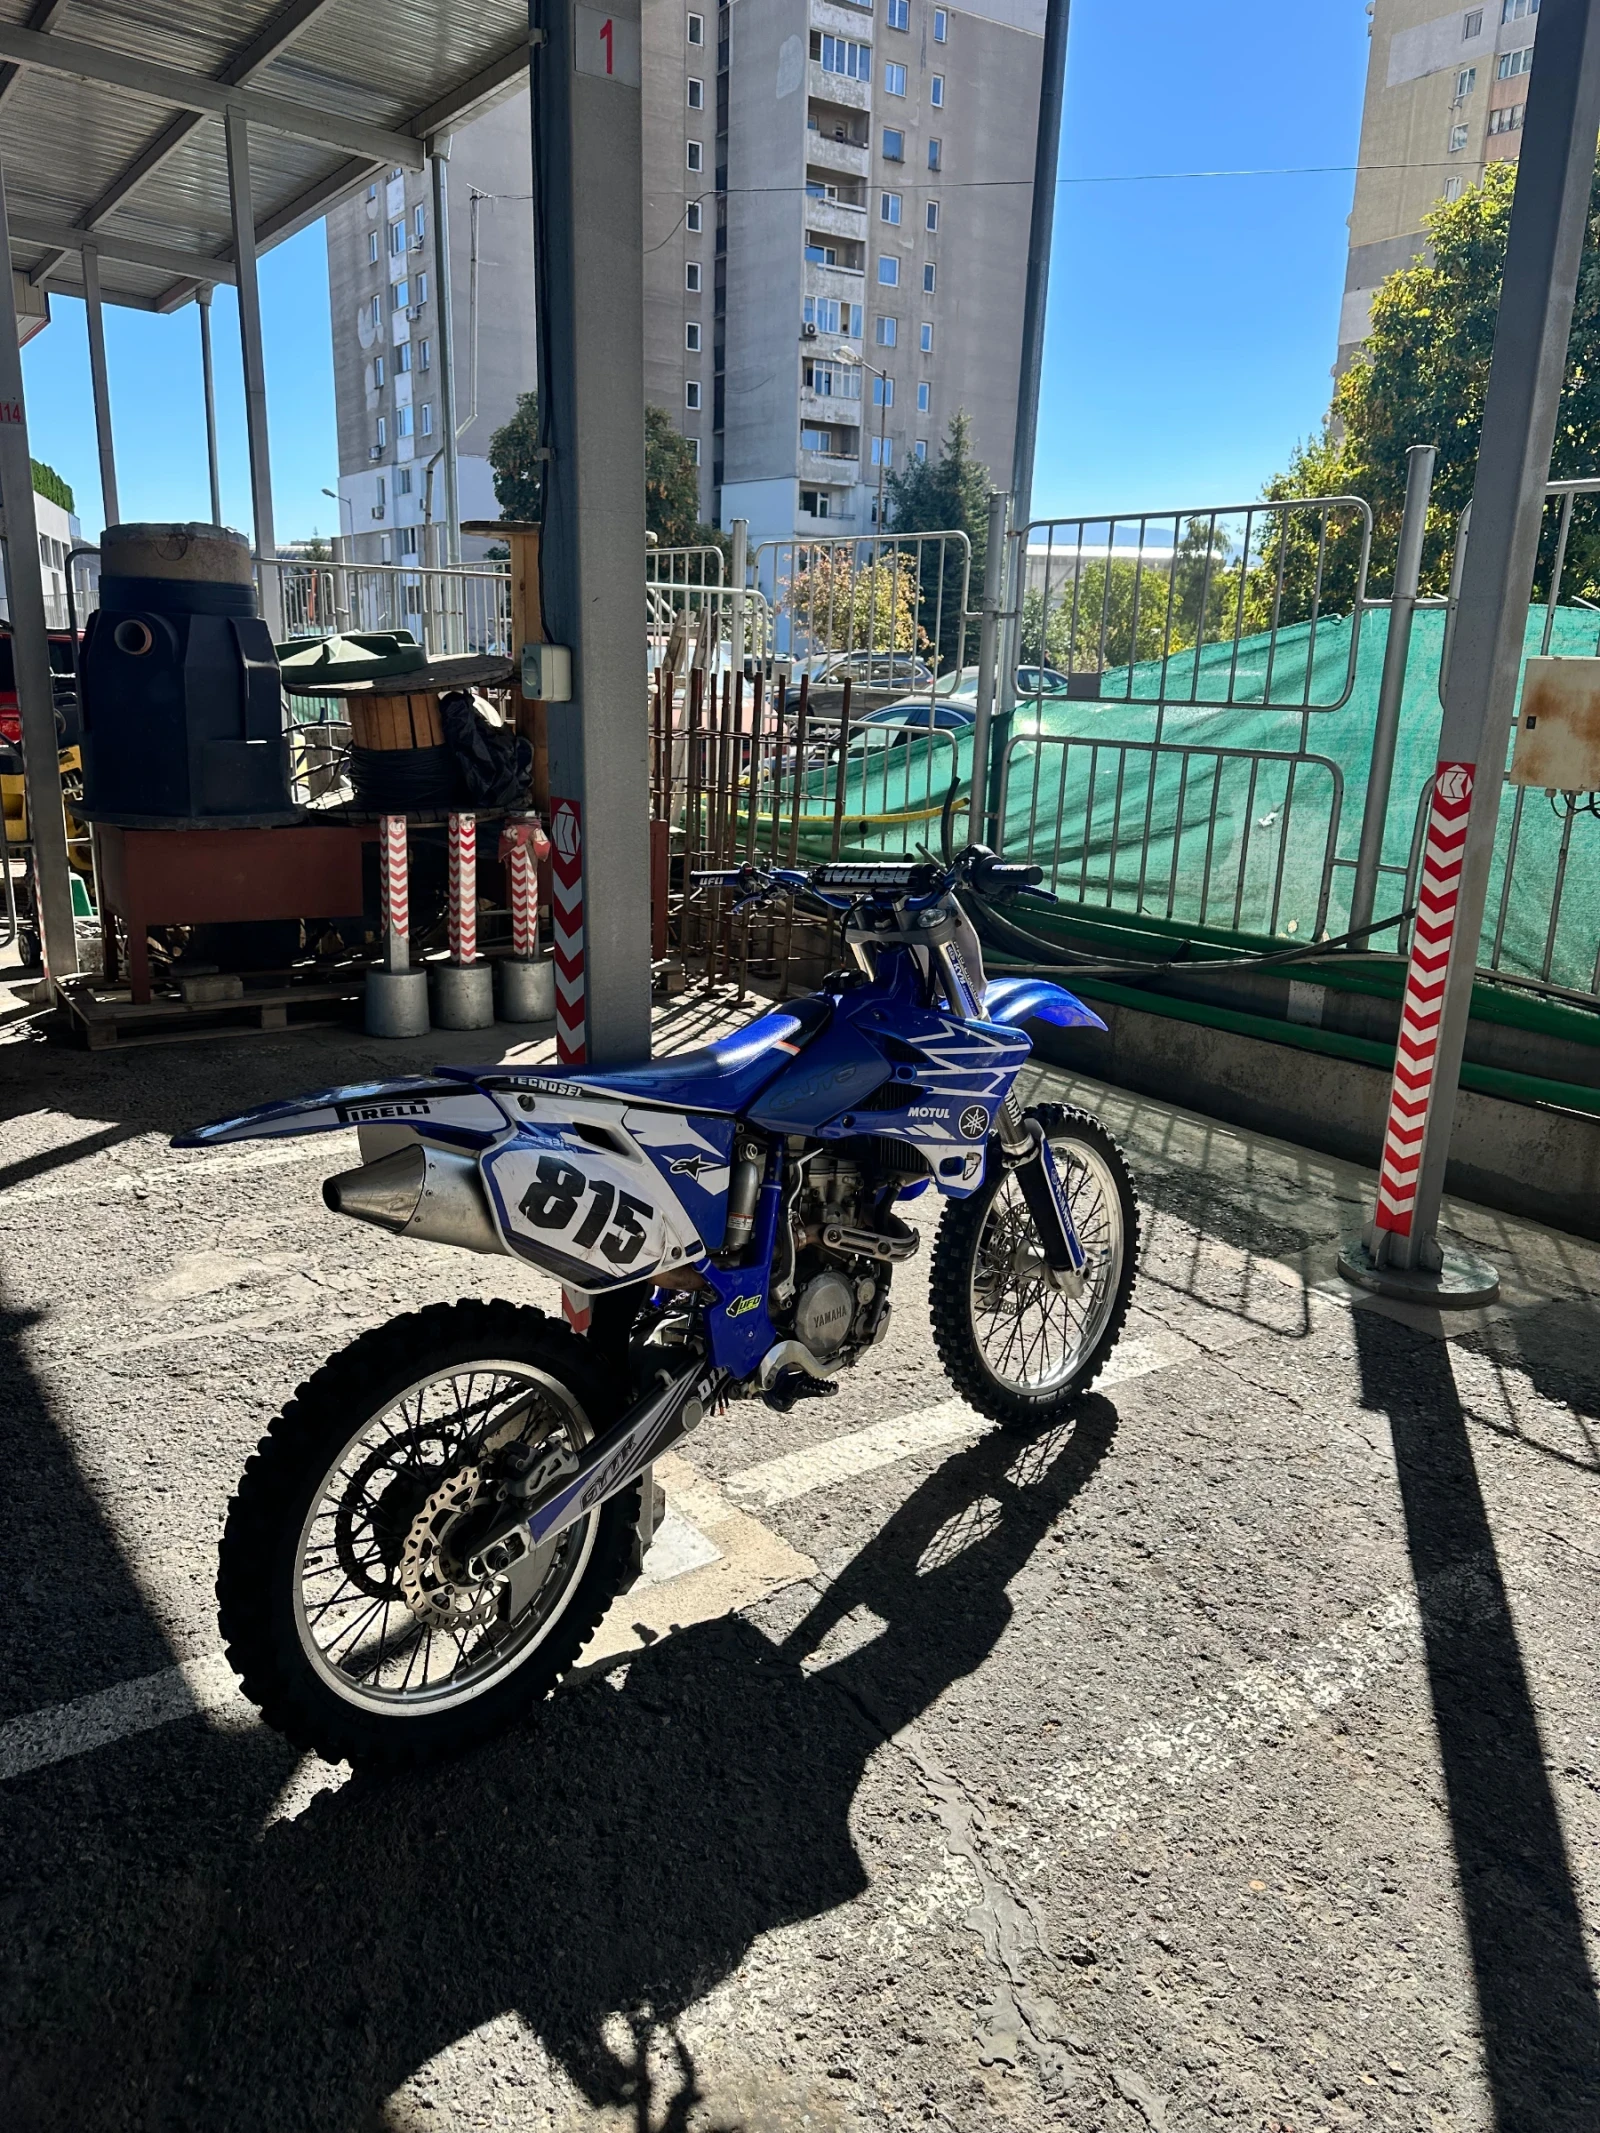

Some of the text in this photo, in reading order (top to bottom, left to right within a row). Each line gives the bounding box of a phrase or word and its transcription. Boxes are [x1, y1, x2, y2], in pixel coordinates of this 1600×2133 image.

[599, 18, 613, 75] 1
[822, 868, 912, 884] RENTHAL
[953, 962, 967, 985] KYB
[508, 1076, 583, 1098] TECNOSEL
[334, 1099, 431, 1124] PIRELLI
[907, 1106, 950, 1119] MOTUL
[1004, 1088, 1023, 1127] MAHA
[518, 1155, 654, 1264] 815
[813, 1304, 847, 1328] YAMAHA
